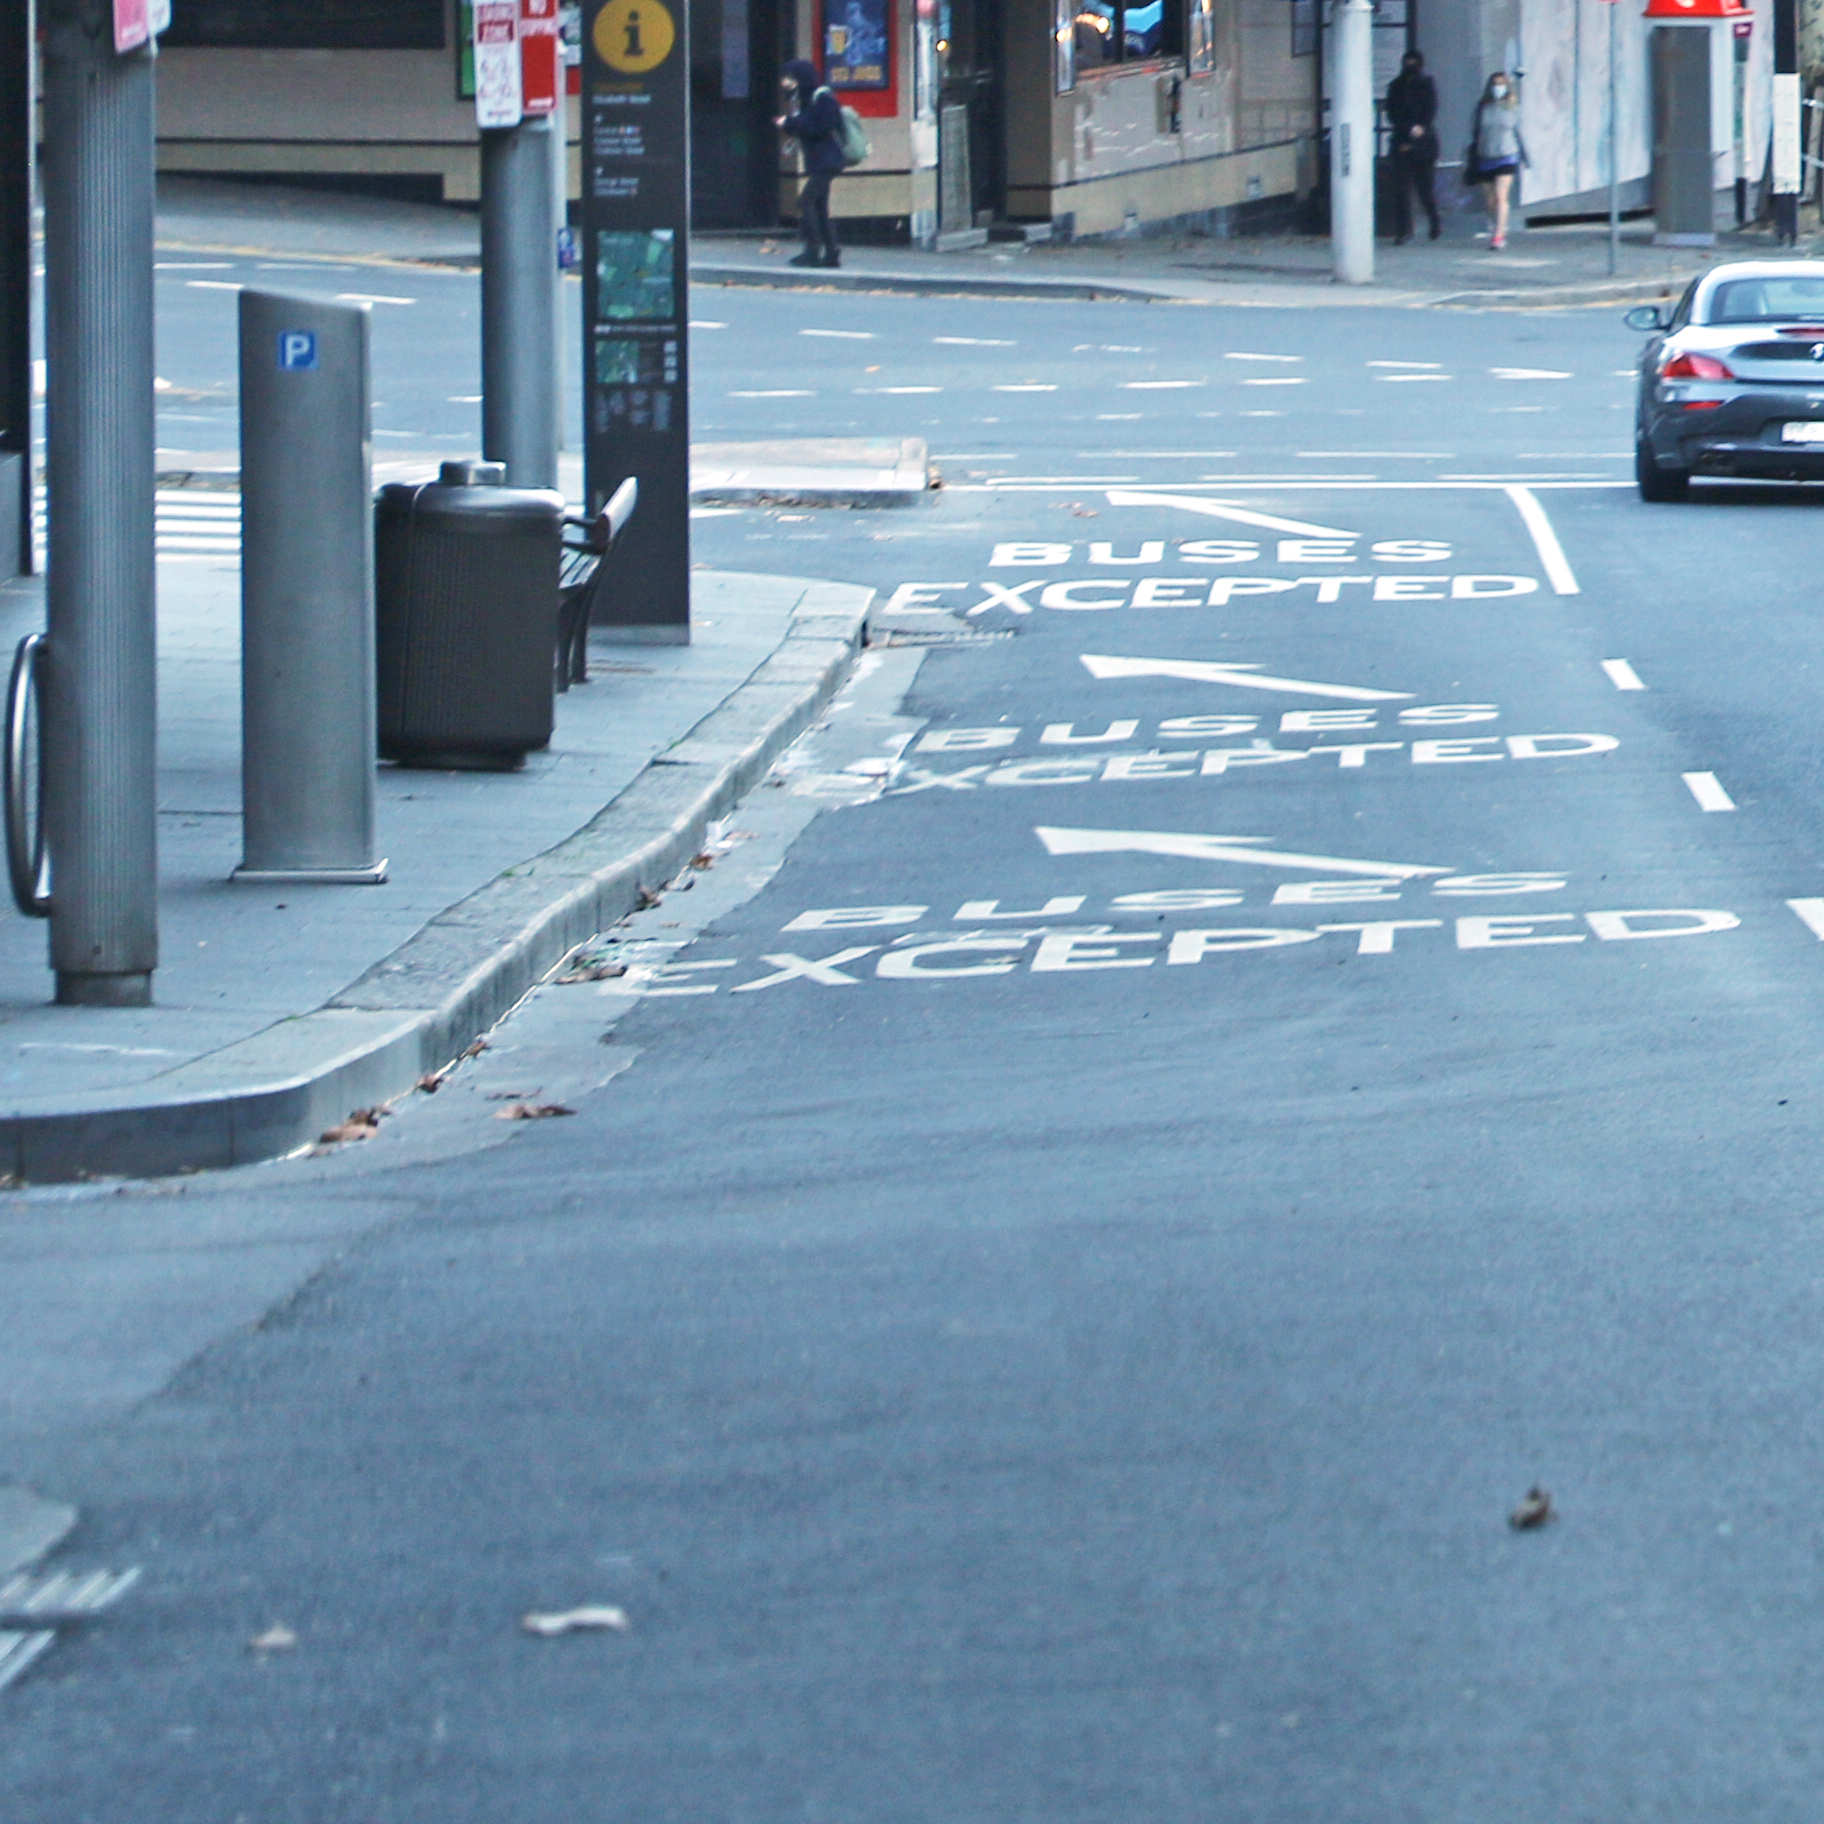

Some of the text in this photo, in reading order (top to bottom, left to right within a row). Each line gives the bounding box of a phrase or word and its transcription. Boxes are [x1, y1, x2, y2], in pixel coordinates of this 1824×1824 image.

[285, 336, 310, 366] P
[987, 538, 1458, 568] BUSES
[884, 573, 1541, 617] EXCEPTED
[914, 702, 1502, 754] BUSES
[779, 870, 1571, 933] BUSES
[622, 907, 1744, 998] EXCEPTED
